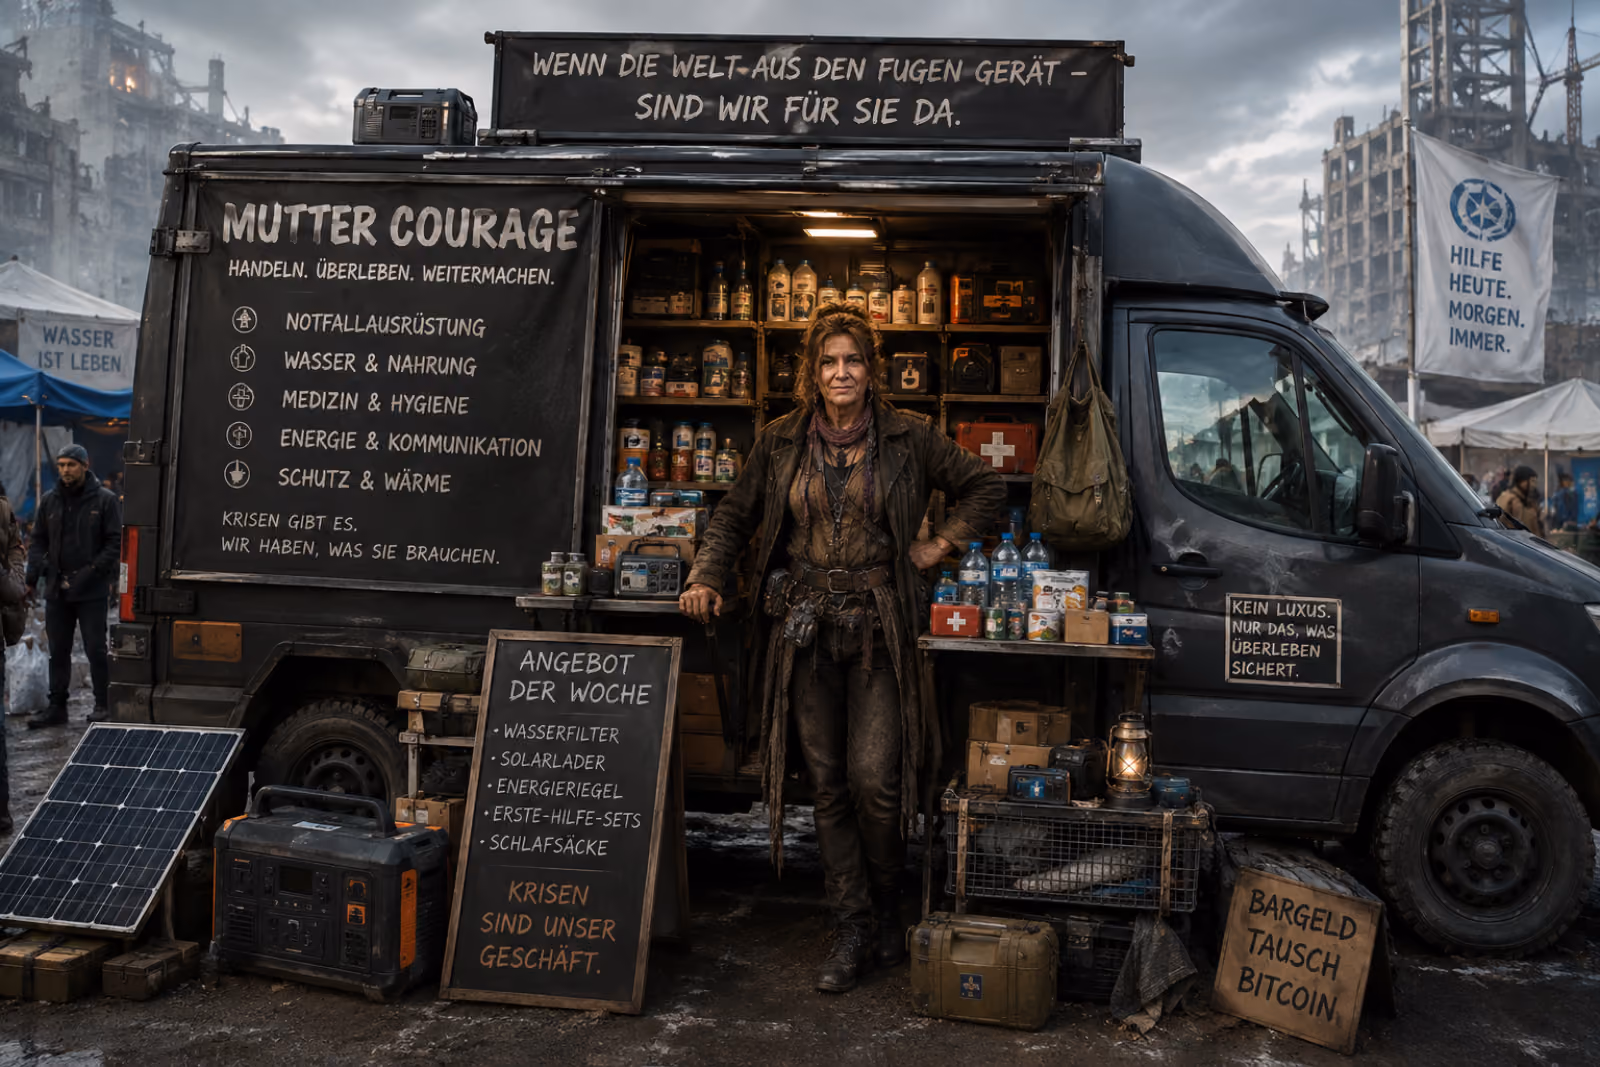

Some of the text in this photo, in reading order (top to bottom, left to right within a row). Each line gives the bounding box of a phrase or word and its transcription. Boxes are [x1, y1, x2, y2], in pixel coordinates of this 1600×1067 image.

[532, 52, 608, 77] WENN
[618, 54, 659, 78] DIE
[672, 54, 741, 80] WELT
[751, 55, 801, 80] AUS
[814, 56, 865, 82] DEN
[877, 58, 964, 84] FUGEN
[974, 55, 1063, 87] GERÄT
[635, 92, 961, 127] SIND WIR FÜR SIE DA.
[222, 202, 580, 252] MUTTER COURAGE
[1450, 245, 1503, 271] HILFE
[228, 258, 555, 286] HANDELN. ÜBERLEBEN. WEITERMACHEN.
[1449, 272, 1512, 299] HEUTE.
[285, 312, 486, 339] NOTFALLAUSRÜSTUNG
[1449, 300, 1525, 328] MORGEN.
[43, 325, 114, 348] WASSER
[1449, 326, 1511, 353] IMMER.
[38, 351, 122, 373] IST LEBEN
[284, 350, 477, 377] WASSER & NAHRUNG
[282, 389, 470, 415] MEDIZIN & HYGIENE
[280, 428, 542, 458] ENERGIE & KOMMUNIKATION
[278, 467, 452, 494] SCHUTZ & WÄRME
[222, 510, 358, 532] KRISEN GIBT ES.
[221, 536, 500, 565] WIR HABEN, WAS SIE BRAUCHEN.
[1232, 600, 1331, 619] KEIN LUXUS.
[1232, 620, 1337, 639] NUR DAS, WAS
[1232, 637, 1321, 658] ÜBERLEBEN
[519, 649, 635, 676] ANGEBOT
[1231, 660, 1299, 678] SICHERT.
[508, 679, 652, 706] DER WOCHE
[503, 723, 620, 744] WASSERFILTER
[500, 751, 606, 772] SOLARLADER
[496, 778, 624, 800] ENERGIERIEGEL
[492, 805, 642, 829] ERSTE-HILFE-SETS
[489, 833, 609, 857] SCHLAFSÄCKE
[508, 880, 589, 907] KRISEN
[480, 911, 616, 943] SIND UNSER
[1248, 889, 1357, 941] BARGELD
[479, 944, 601, 975] GESCHÄFT.
[1247, 927, 1341, 981] TAUSCH
[1237, 966, 1337, 1022] BITCOIN
